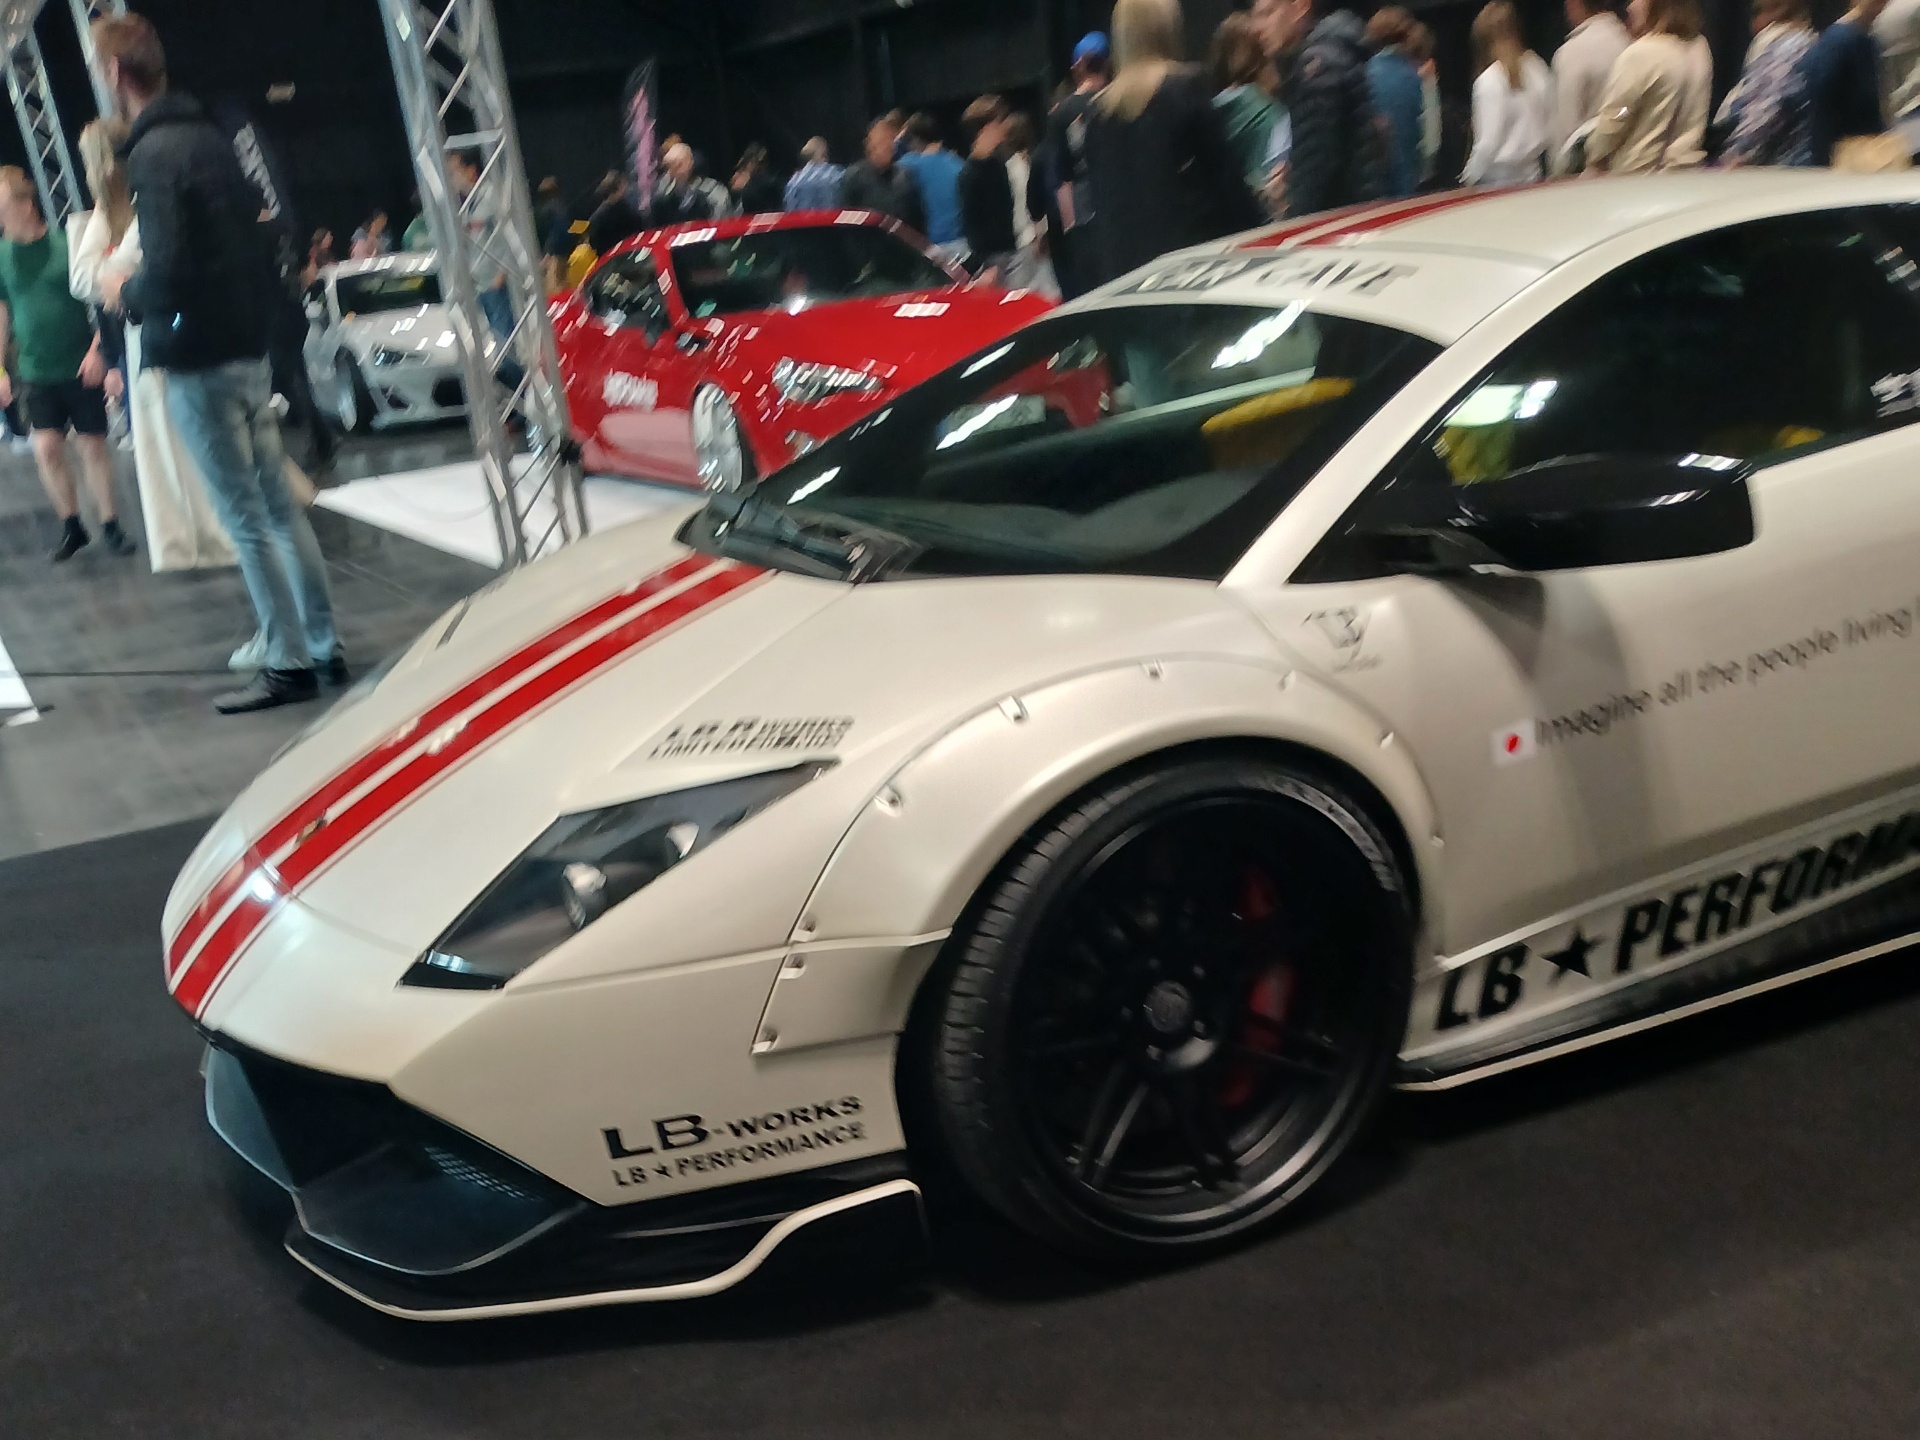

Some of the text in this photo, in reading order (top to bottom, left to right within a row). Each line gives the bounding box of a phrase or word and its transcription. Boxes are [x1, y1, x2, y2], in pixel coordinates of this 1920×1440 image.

[1535, 607, 1913, 746] Imagine all the people living
[1434, 940, 1532, 1031] LB
[611, 1120, 869, 1187] LB PERFORMANCE
